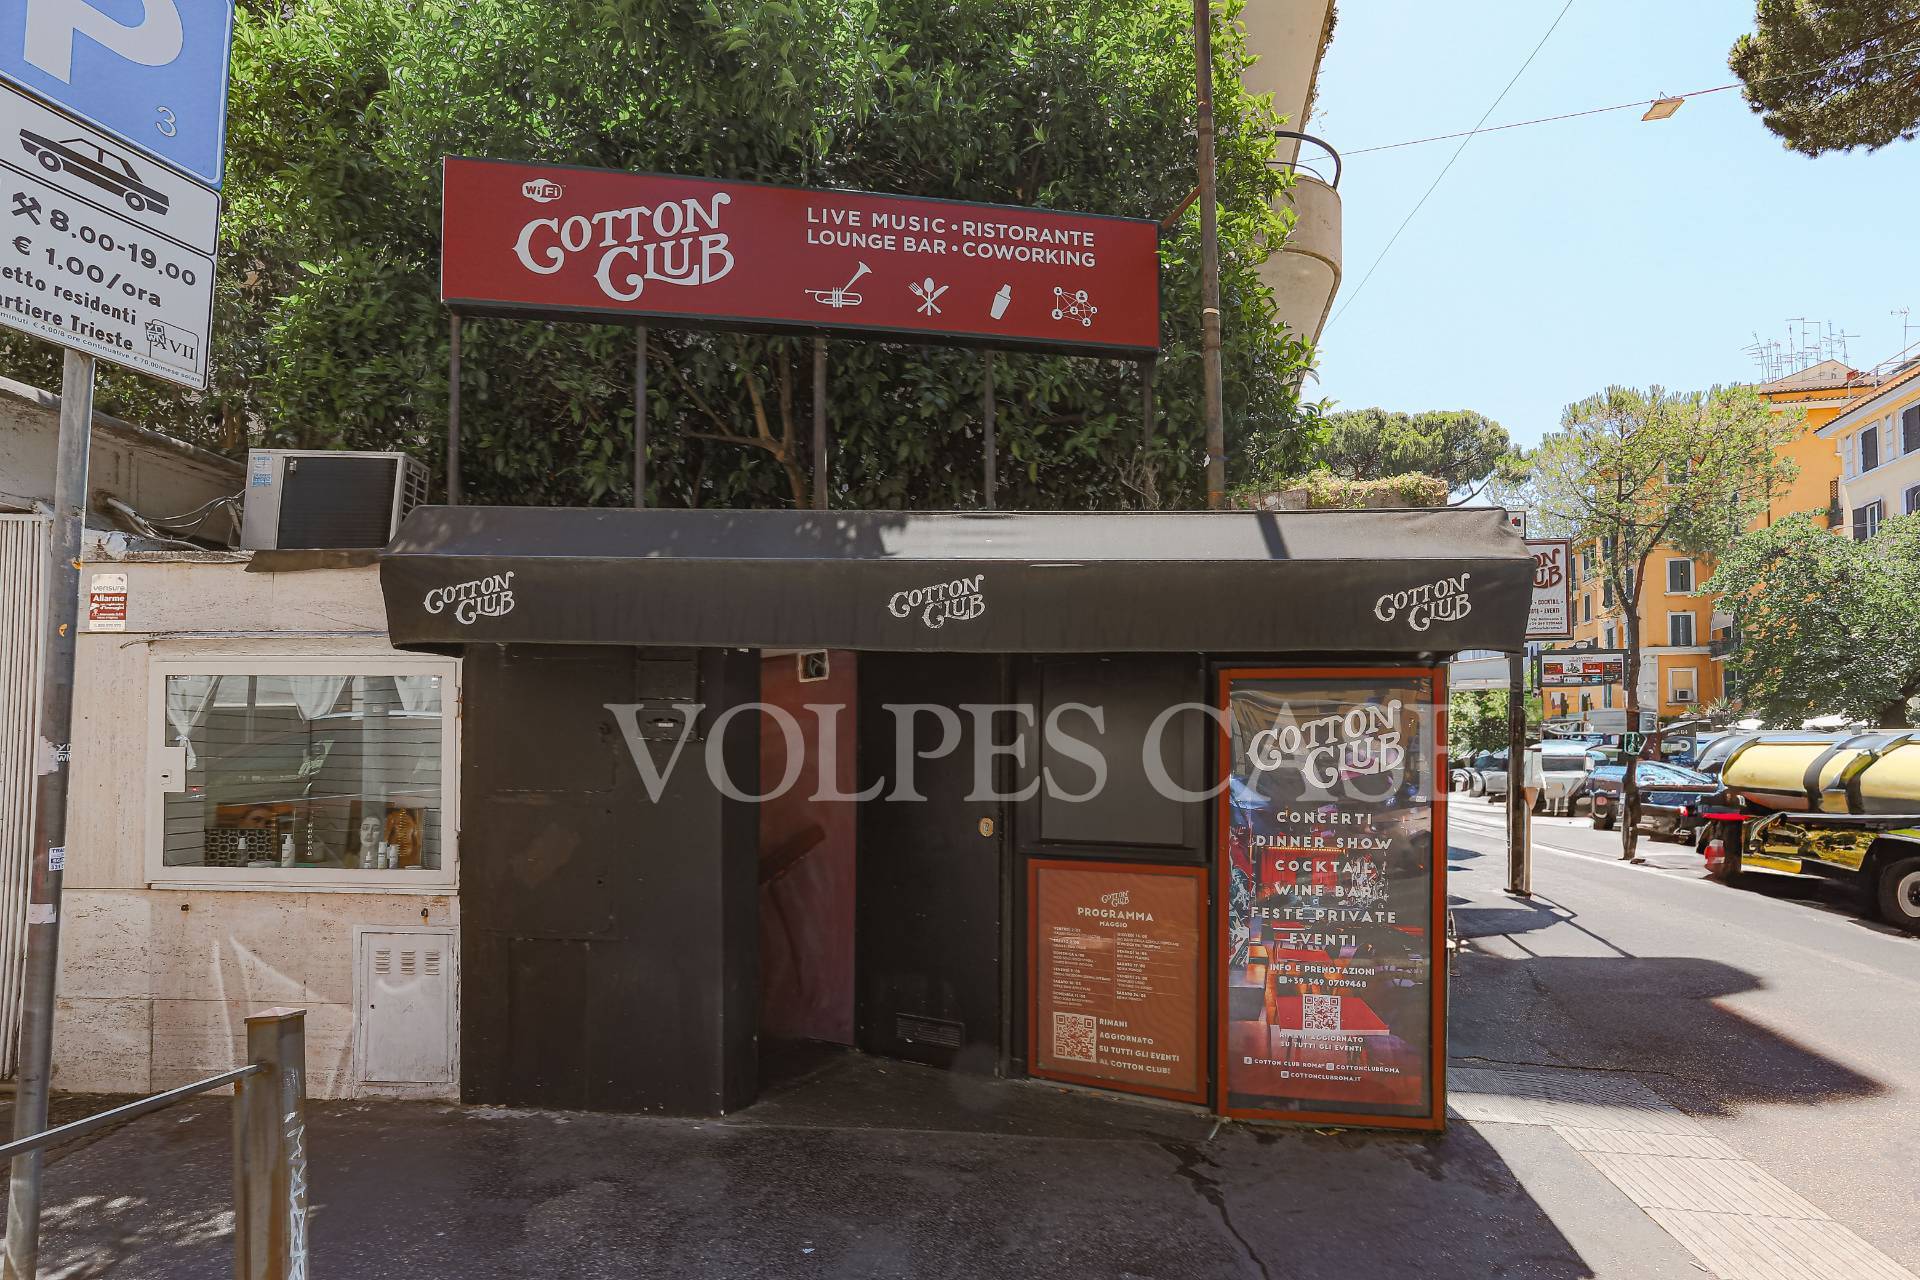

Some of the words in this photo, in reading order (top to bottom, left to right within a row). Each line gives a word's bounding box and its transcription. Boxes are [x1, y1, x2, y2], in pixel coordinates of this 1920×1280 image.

[155, 106, 178, 138] 3
[512, 192, 732, 275] COTTON
[807, 207, 862, 227] LIVE
[872, 213, 946, 234] MUSIC
[962, 220, 1095, 248] RISTORANTE
[12, 235, 32, 256] €
[50, 208, 196, 287] 8.00-19.00
[807, 228, 896, 251] LOUNGE
[903, 238, 947, 255] BAR
[962, 241, 1096, 268] COWORKING
[593, 232, 735, 302] CLUB
[54, 285, 137, 326] residenti
[67, 333, 81, 343] ore
[71, 314, 133, 351] Trieste
[93, 594, 125, 602] Allarme
[423, 571, 515, 614] COTTON
[887, 574, 985, 618] COTTON
[1373, 572, 1471, 622] COTTON
[454, 590, 515, 625] CLUB
[922, 593, 986, 629] CLUB
[1408, 593, 1472, 632] CLUB
[1246, 699, 1402, 773] COTTON
[1300, 731, 1406, 789] CLUB
[1276, 811, 1372, 825] CONCERTI
[1256, 834, 1325, 849] DINNER
[1336, 837, 1393, 850] SHOW
[1275, 859, 1373, 874] COCKTAIL
[1273, 883, 1325, 898] WINE
[1335, 885, 1373, 898] BAR
[1077, 906, 1154, 922] PROGRAMMA
[1250, 906, 1305, 920] FESTE
[1315, 909, 1397, 924] PRIVATE
[1099, 921, 1128, 929] MAGGIO
[1289, 932, 1357, 947] EVENTI
[1270, 963, 1292, 971] INFO
[1295, 963, 1301, 972] E
[1304, 965, 1375, 976] PRENOTAZIONI
[1288, 977, 1304, 985] +39
[1309, 978, 1325, 986] 349
[1328, 979, 1367, 988] 0709468
[1099, 1018, 1128, 1028] RIMANI
[1099, 1031, 1154, 1045] AGGIORNATO
[1292, 1041, 1317, 1049] TUTTI
[1099, 1044, 1109, 1053] SU
[1111, 1045, 1133, 1057] TUTTI
[1135, 1049, 1149, 1059] GLI
[1150, 1051, 1180, 1062] EVENTI
[1099, 1058, 1109, 1066] AL
[1110, 1059, 1144, 1071] COTTON
[1146, 1063, 1170, 1075] CLUB!
[1254, 1058, 1281, 1066] COTTON
[1283, 1060, 1300, 1068] CLUB
[1336, 1063, 1400, 1074] COTTONCLUBROMA
